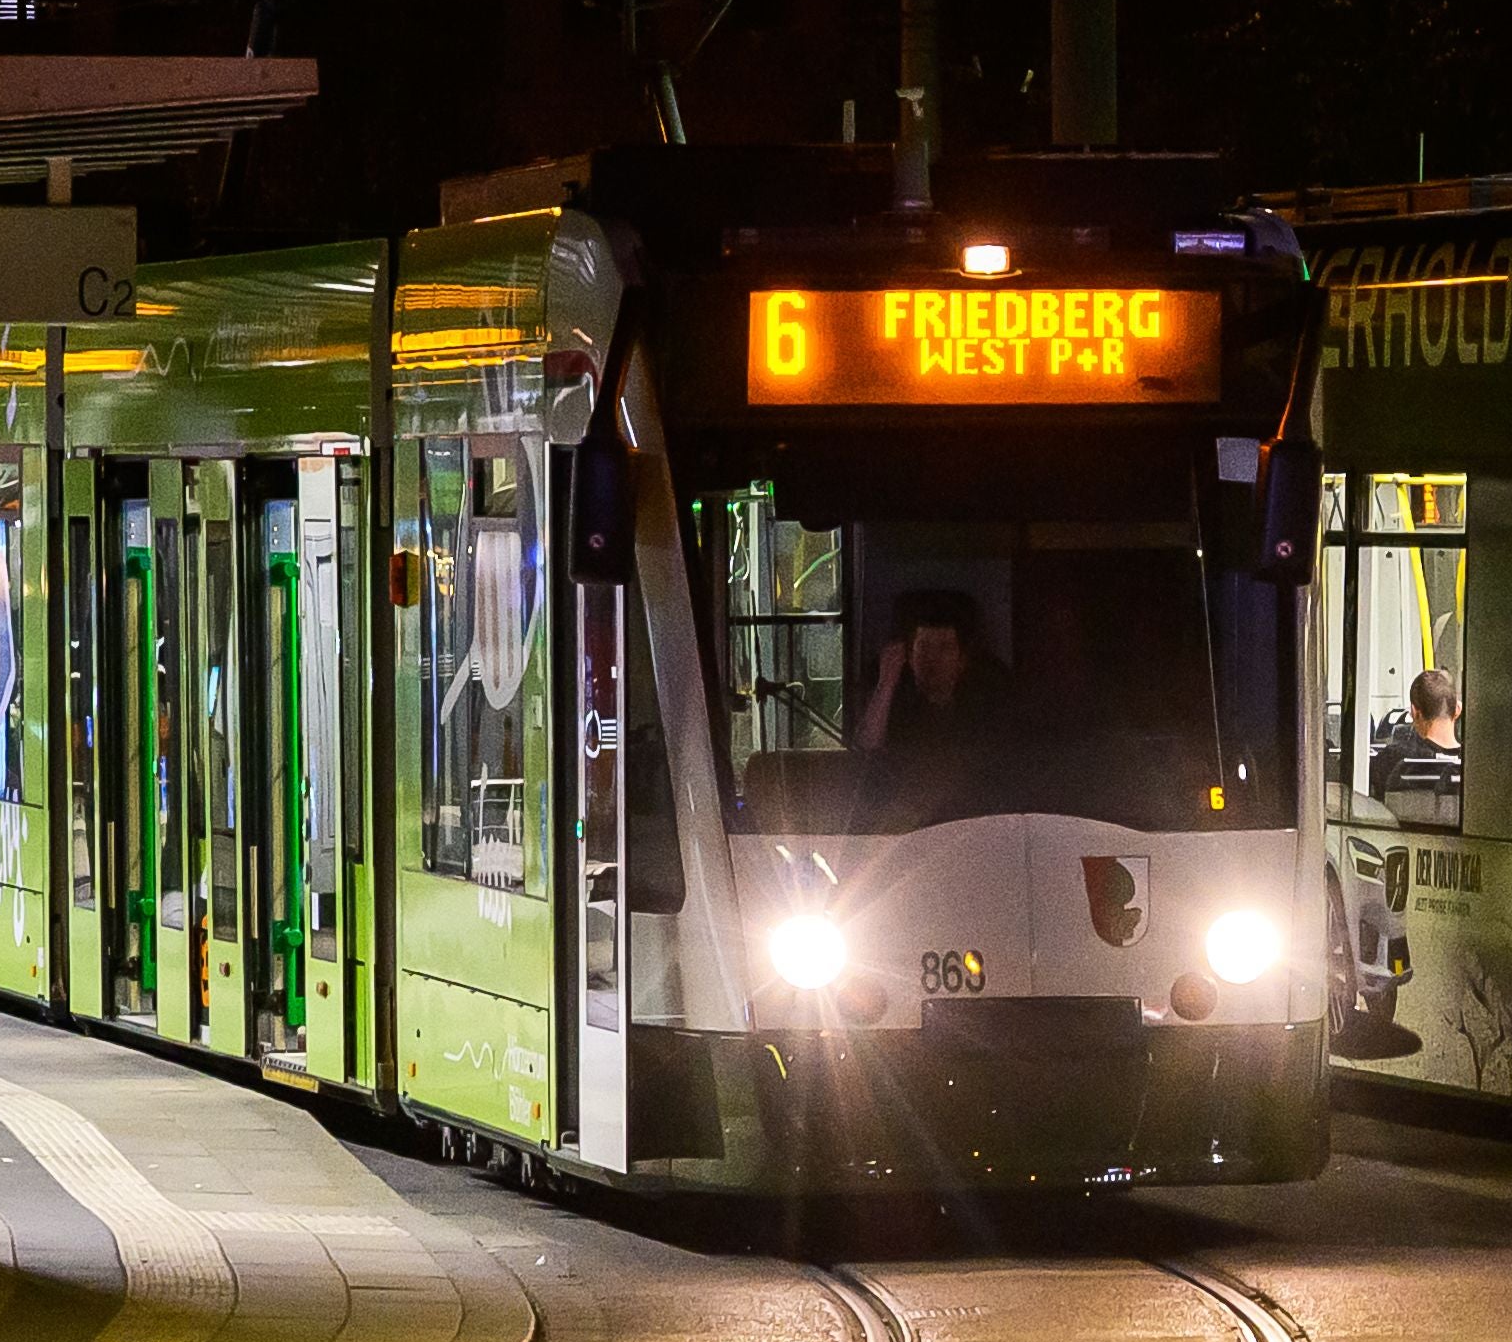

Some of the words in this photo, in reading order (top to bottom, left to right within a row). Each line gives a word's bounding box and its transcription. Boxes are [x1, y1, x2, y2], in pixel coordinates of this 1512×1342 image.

[79, 267, 133, 317] C2
[766, 292, 806, 375] 6
[884, 292, 1160, 338] FRIEDBERG
[920, 338, 1031, 375] WEST
[1050, 338, 1125, 375] P+R
